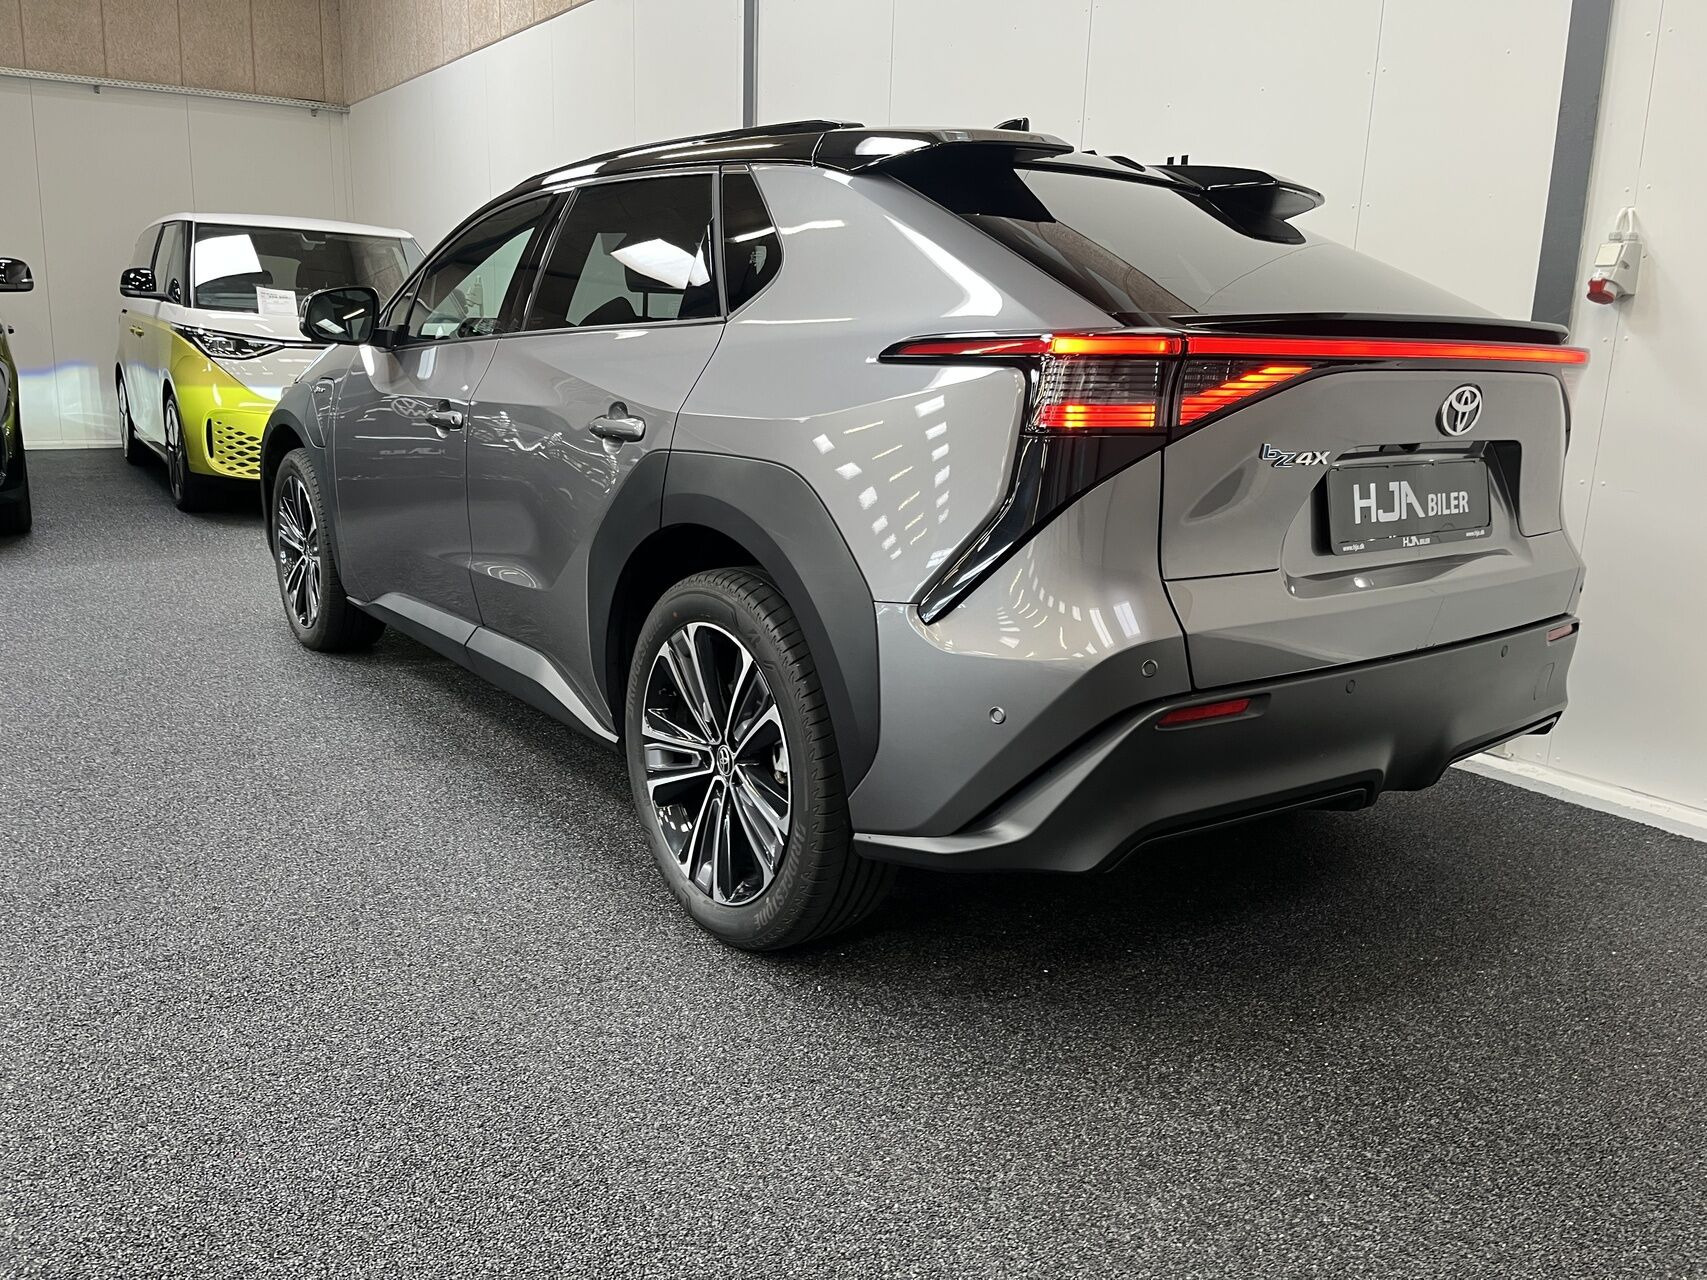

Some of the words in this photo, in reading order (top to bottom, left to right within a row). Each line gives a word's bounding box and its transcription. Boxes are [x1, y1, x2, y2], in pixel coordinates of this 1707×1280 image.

[1353, 480, 1426, 525] HJA
[1427, 491, 1470, 517] BILER
[753, 819, 807, 931] BRIDGESTONE
